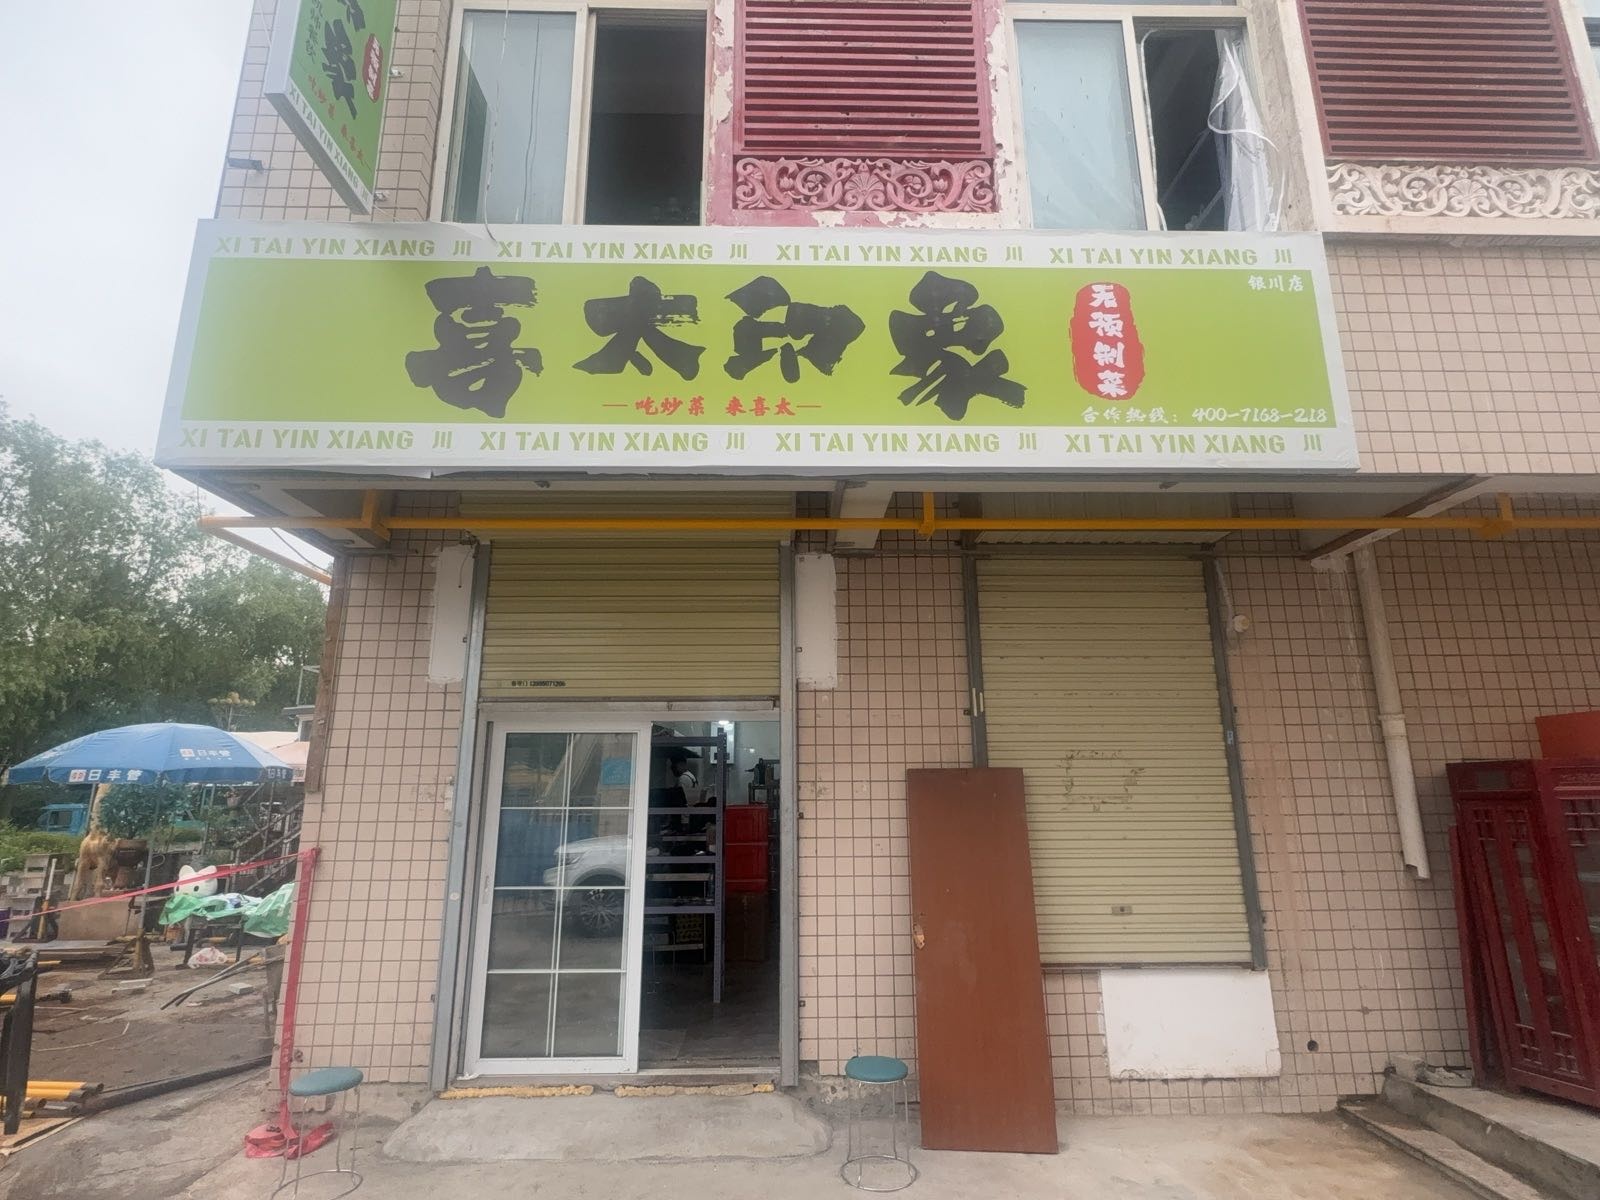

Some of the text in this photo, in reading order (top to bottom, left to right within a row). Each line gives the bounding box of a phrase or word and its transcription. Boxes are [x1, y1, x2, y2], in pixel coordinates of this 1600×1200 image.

[302, 103, 317, 130] TAI
[215, 237, 241, 254] XI
[250, 237, 293, 255] TAI
[302, 238, 346, 256] YIN
[353, 239, 435, 257] XIANG
[497, 241, 522, 258] XI
[531, 241, 572, 258] TAI
[582, 242, 625, 259] YIN
[633, 243, 713, 260] XIANG
[776, 244, 800, 261] XI
[809, 244, 850, 261] TAI
[858, 245, 901, 262] YIN
[909, 245, 988, 262] XIANG
[1049, 247, 1074, 264] XI
[1081, 247, 1122, 264] TAI
[1130, 248, 1173, 264] YIN
[1181, 248, 1258, 265] XIANG
[1248, 275, 1304, 292] 银川店
[405, 266, 1027, 421] 喜太印象
[1088, 284, 1127, 398] 无预制菜
[635, 396, 705, 416] 吃炒菜
[1191, 407, 1328, 424] 400-7168-218
[179, 427, 208, 448] XI
[217, 428, 263, 448] TAI
[272, 428, 319, 449] YIN
[327, 430, 414, 450] XIANG
[479, 431, 506, 450] XI
[515, 431, 560, 451] TAI
[569, 431, 615, 451] YIN
[624, 432, 709, 452] XIANG
[775, 432, 800, 452] XI
[810, 432, 854, 452] TAI
[862, 433, 909, 453] YIN
[916, 433, 1000, 453] XIANG
[1065, 434, 1091, 453] XI
[1098, 434, 1142, 453] TAI
[1150, 434, 1196, 453] YIN
[1203, 434, 1285, 454] XIANG
[88, 769, 143, 781] 日丰管
